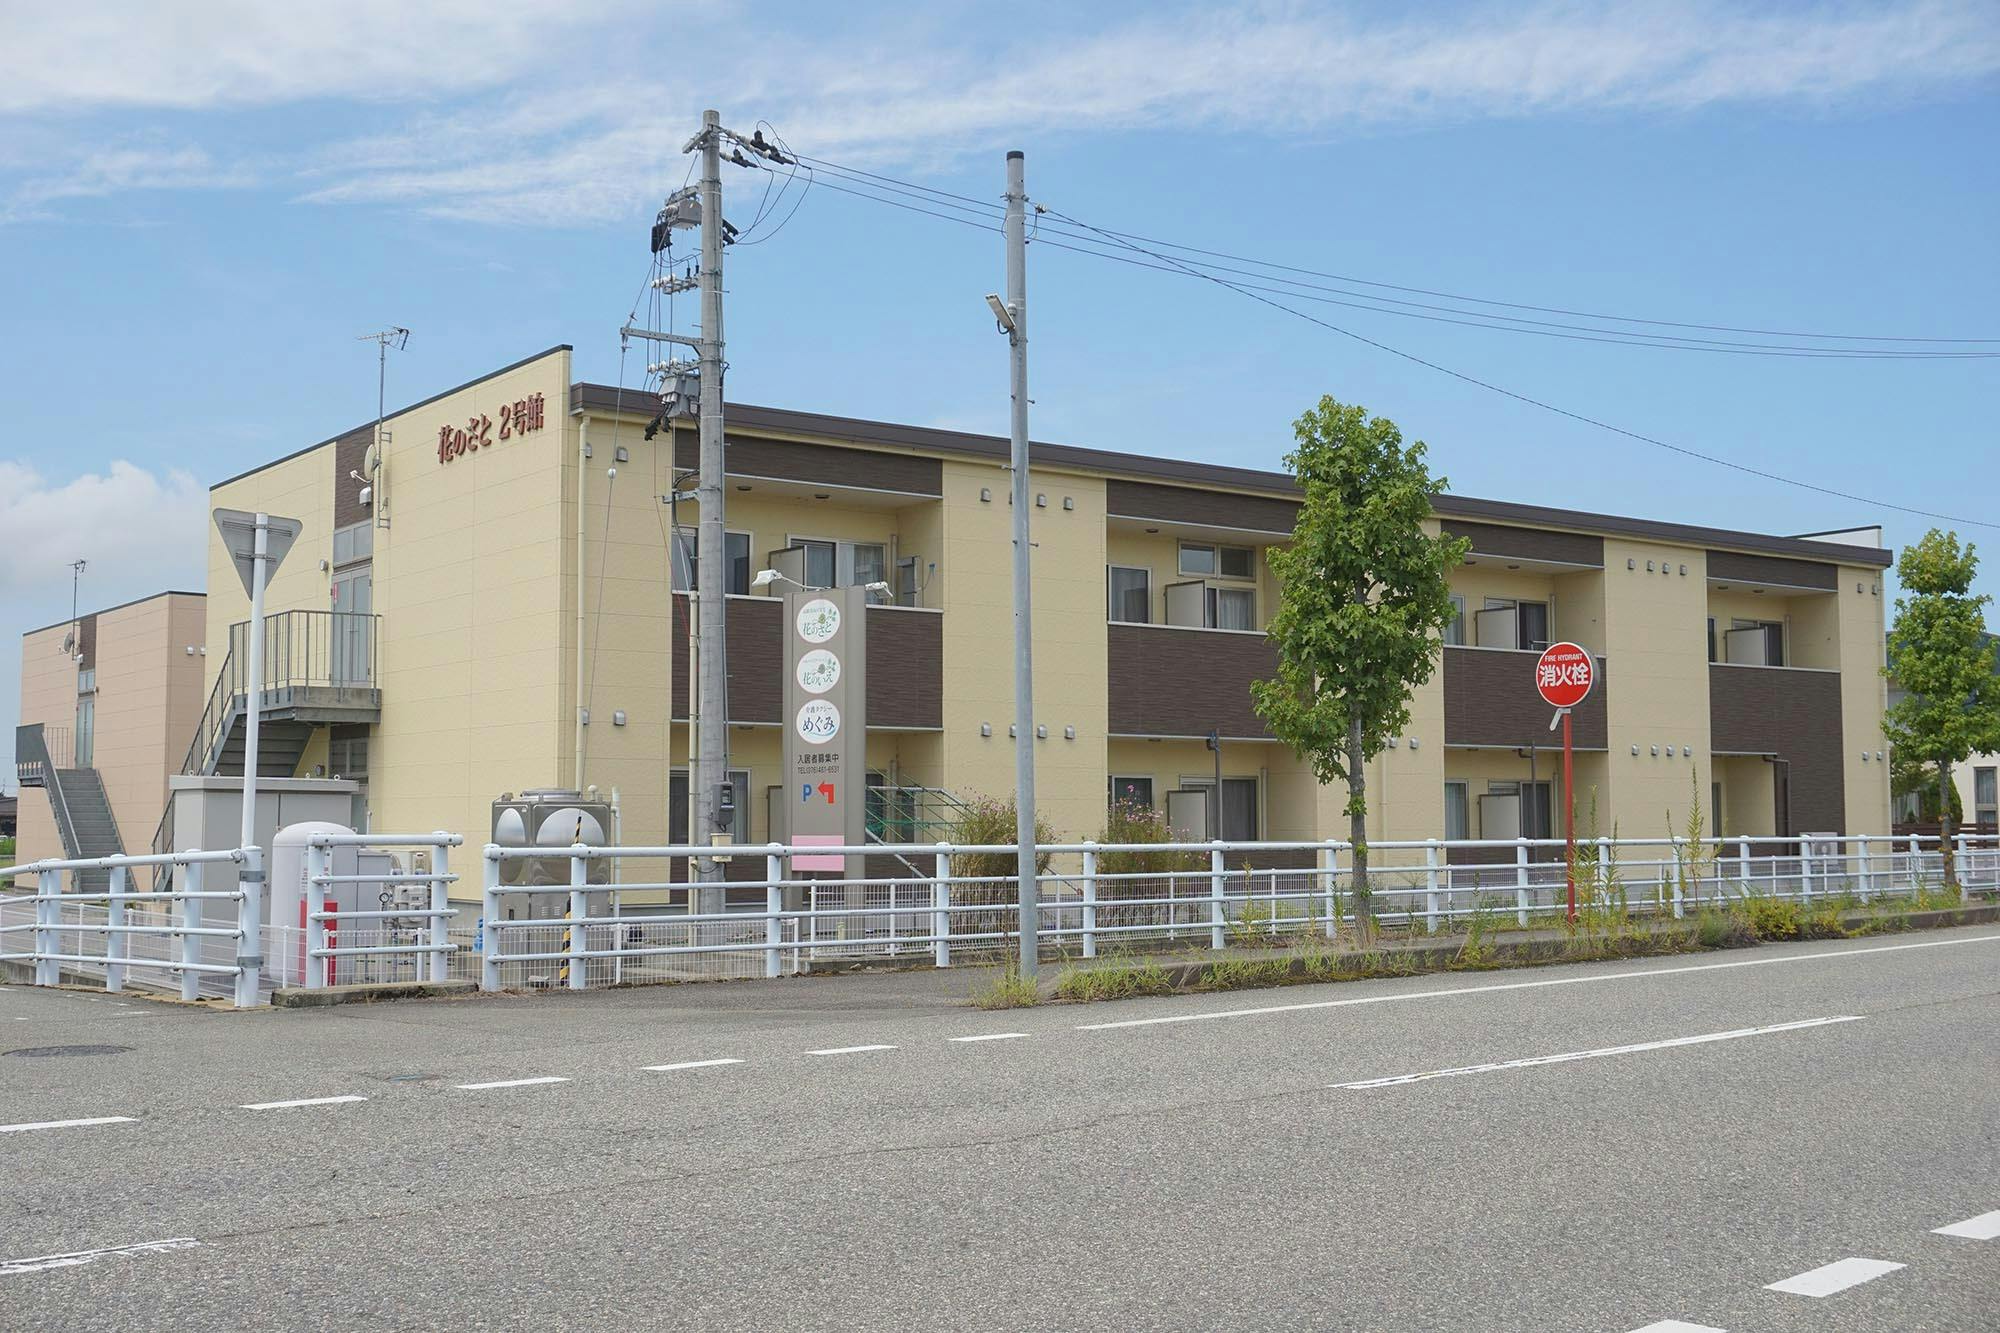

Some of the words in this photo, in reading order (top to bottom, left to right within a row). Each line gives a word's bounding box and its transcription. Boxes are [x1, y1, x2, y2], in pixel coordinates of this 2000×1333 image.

[437, 413, 492, 464] 花のさと
[499, 392, 545, 440] 2号館
[802, 622, 832, 638] 花のさと
[1540, 662, 1589, 687] 消火栓
[803, 716, 835, 732] めぐみ
[797, 753, 839, 764] 入居者募集中
[803, 783, 812, 802] P
